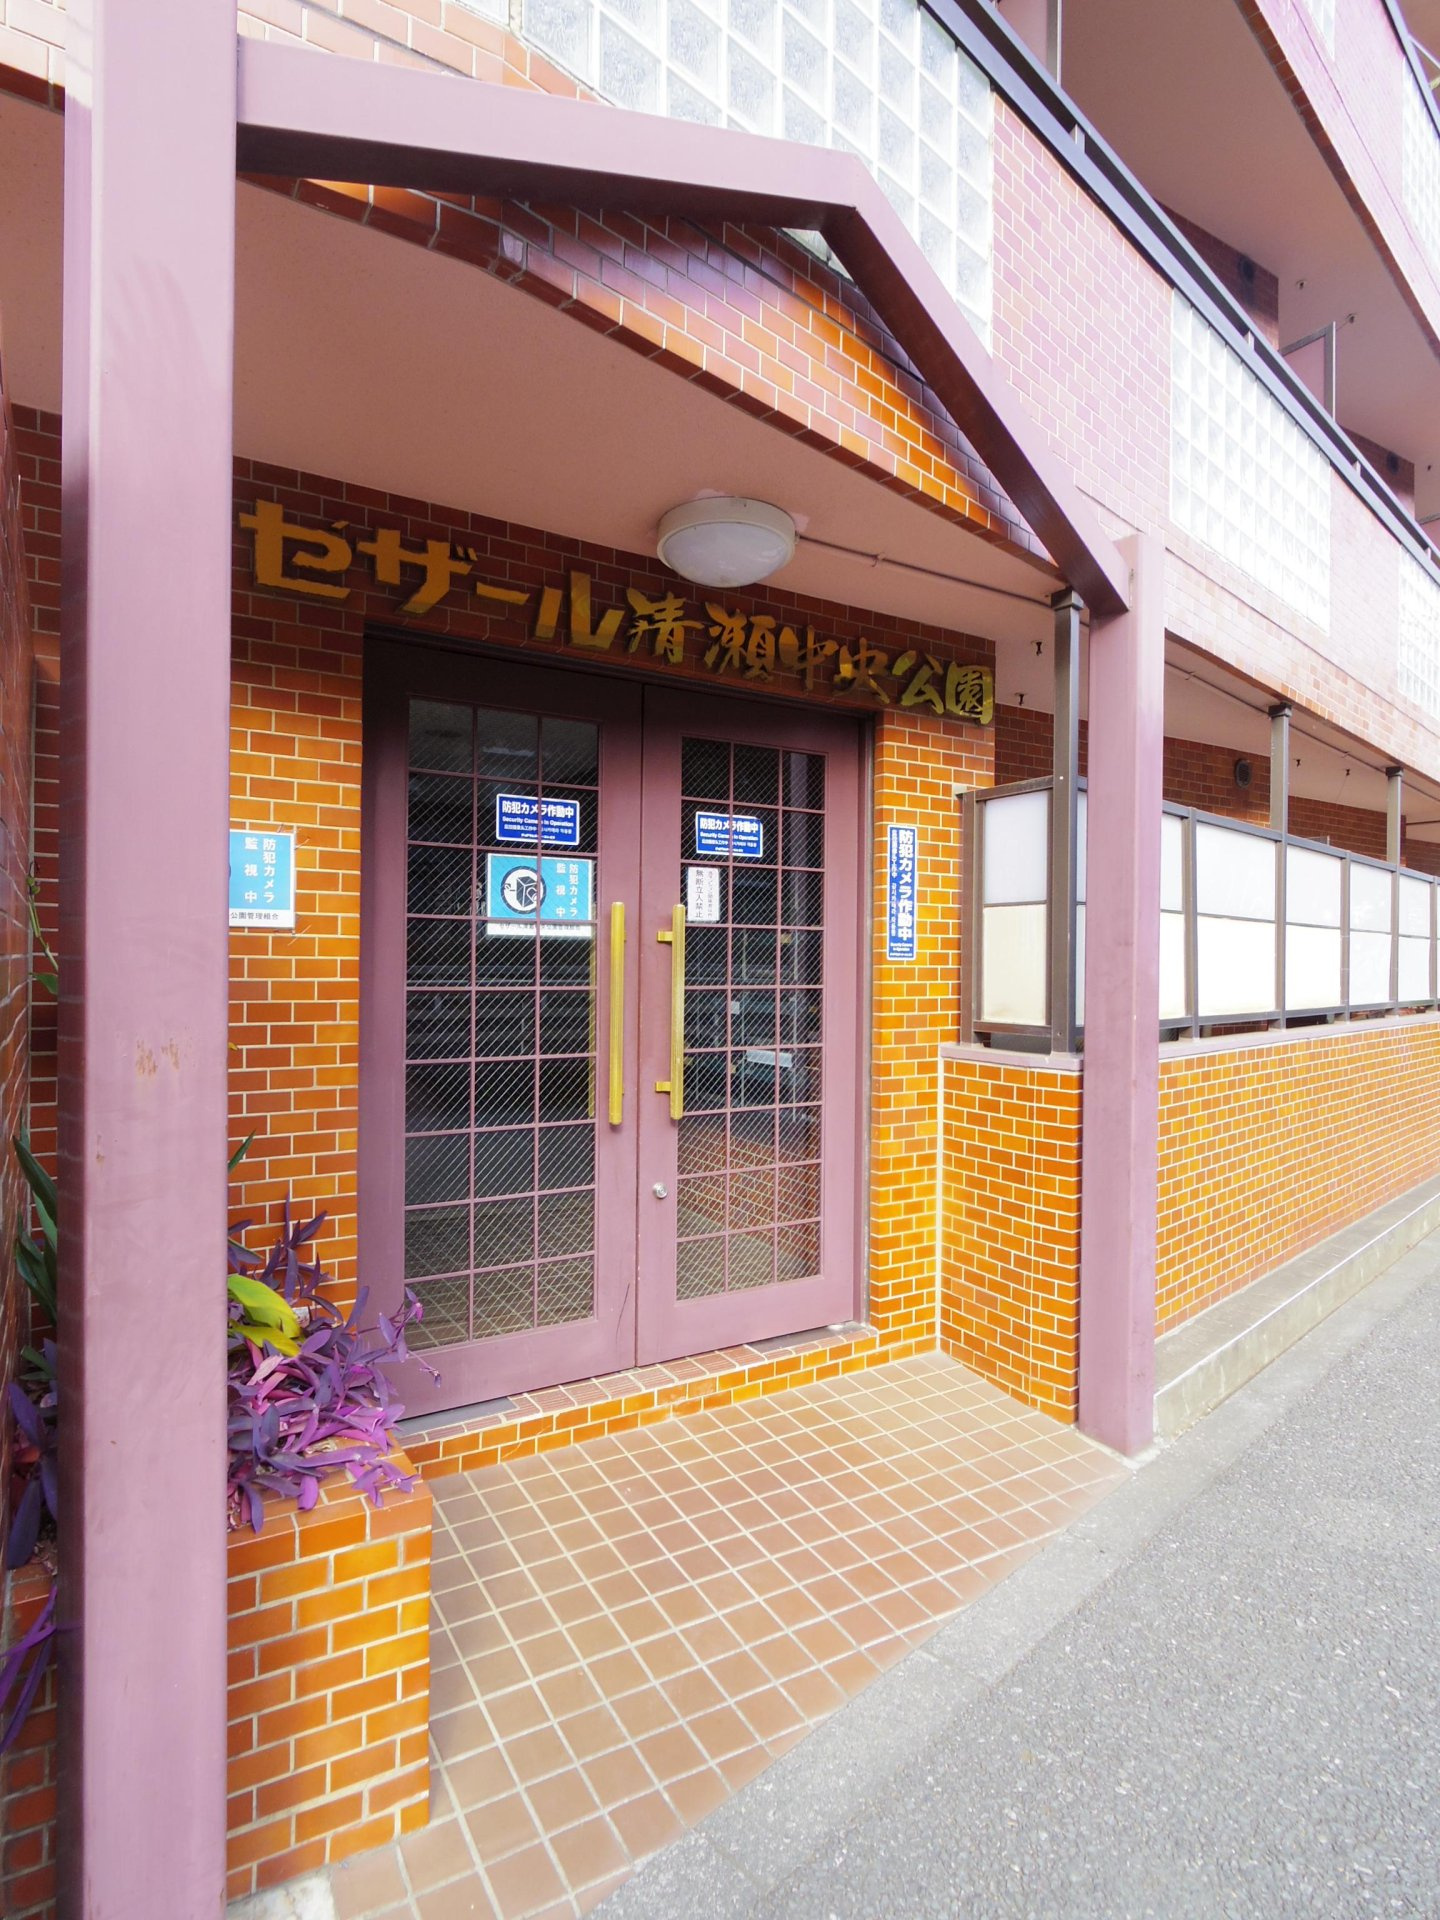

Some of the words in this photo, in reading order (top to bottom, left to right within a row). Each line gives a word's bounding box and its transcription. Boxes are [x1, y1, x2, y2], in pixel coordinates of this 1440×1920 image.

[502, 800, 574, 819] 防犯カメラ作動中
[502, 816, 524, 825] Security
[550, 820, 574, 828] Operation
[700, 817, 758, 833] 防犯カメラ作動中
[244, 837, 258, 904] 監視中
[262, 838, 276, 904] 防犯カメラ
[556, 863, 566, 917] 監視中
[569, 864, 578, 917] 防犯カメラ
[695, 869, 704, 918] 無断立入禁止
[898, 829, 914, 941] 防犯カメラ作動中
